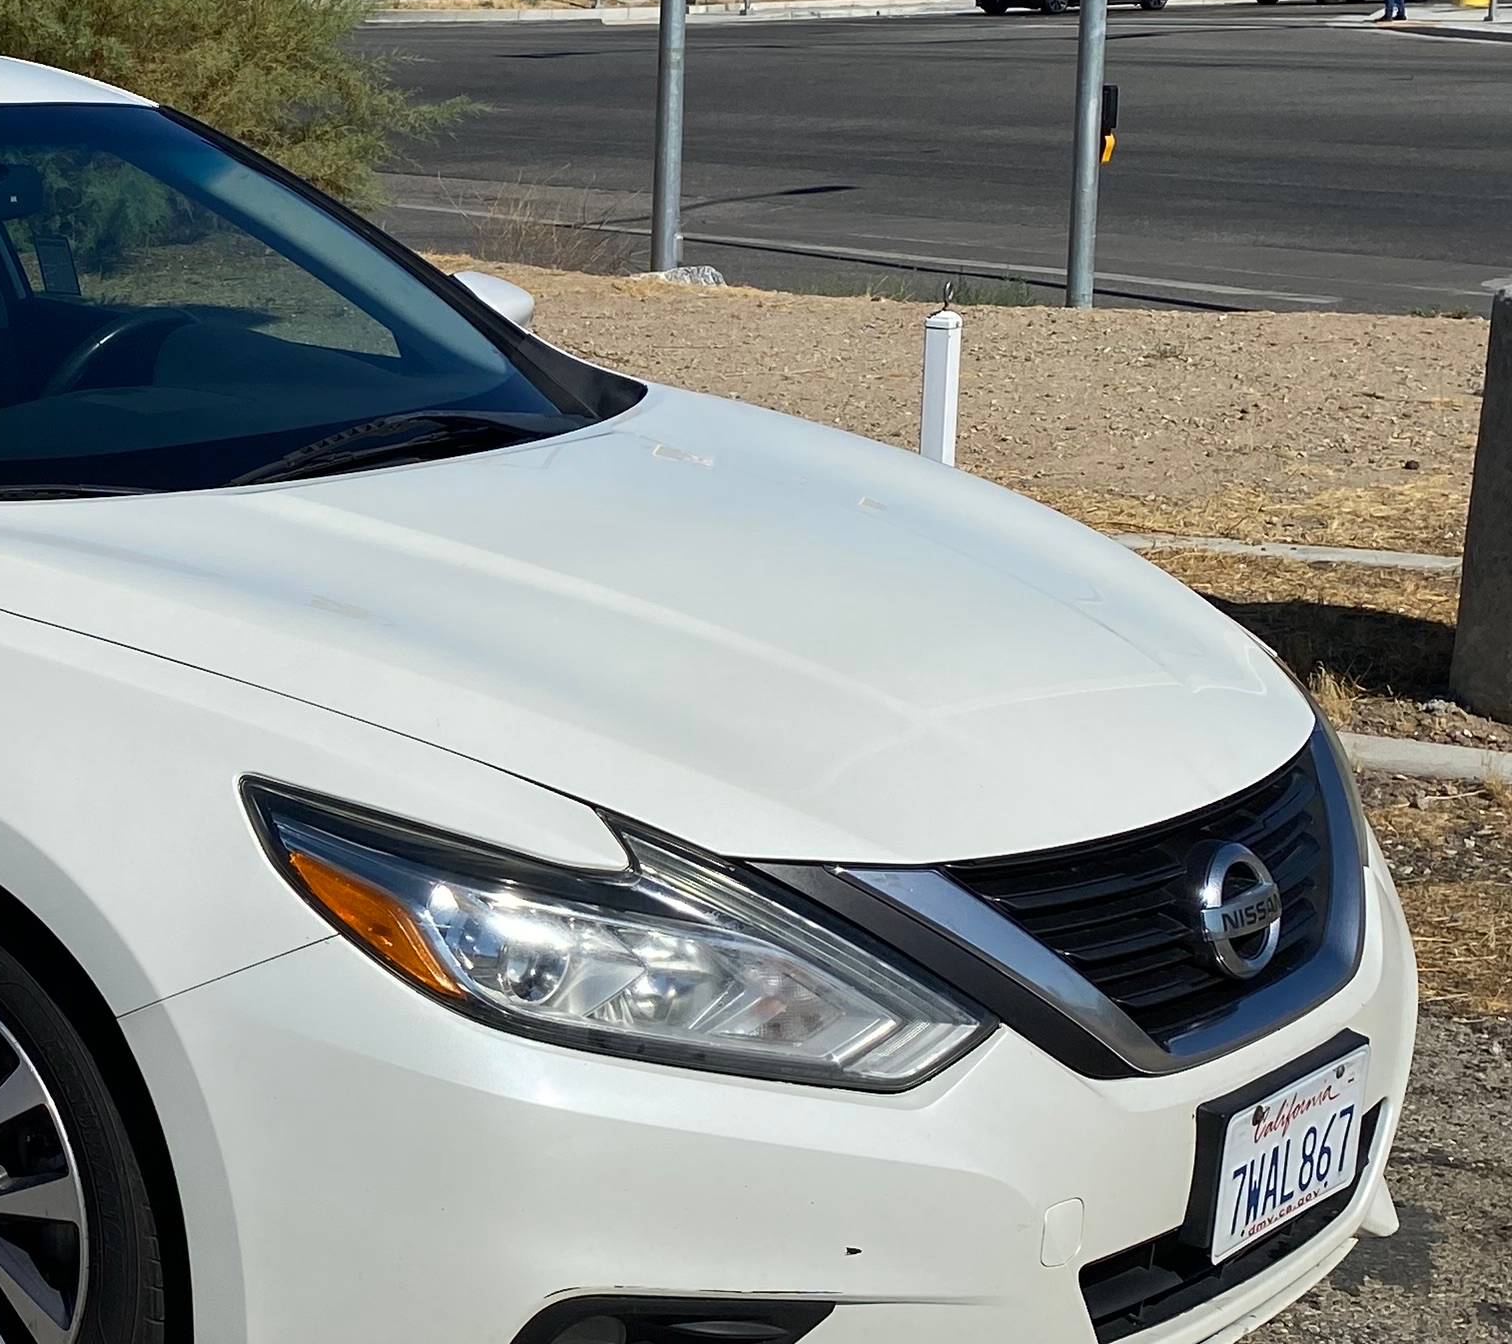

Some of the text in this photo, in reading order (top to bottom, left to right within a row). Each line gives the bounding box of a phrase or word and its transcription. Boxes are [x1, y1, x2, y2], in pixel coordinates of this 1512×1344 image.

[1252, 1084, 1340, 1144] California
[1230, 1103, 1355, 1236] 7WAL867
[1247, 1188, 1321, 1237] dmv.ca.gov
